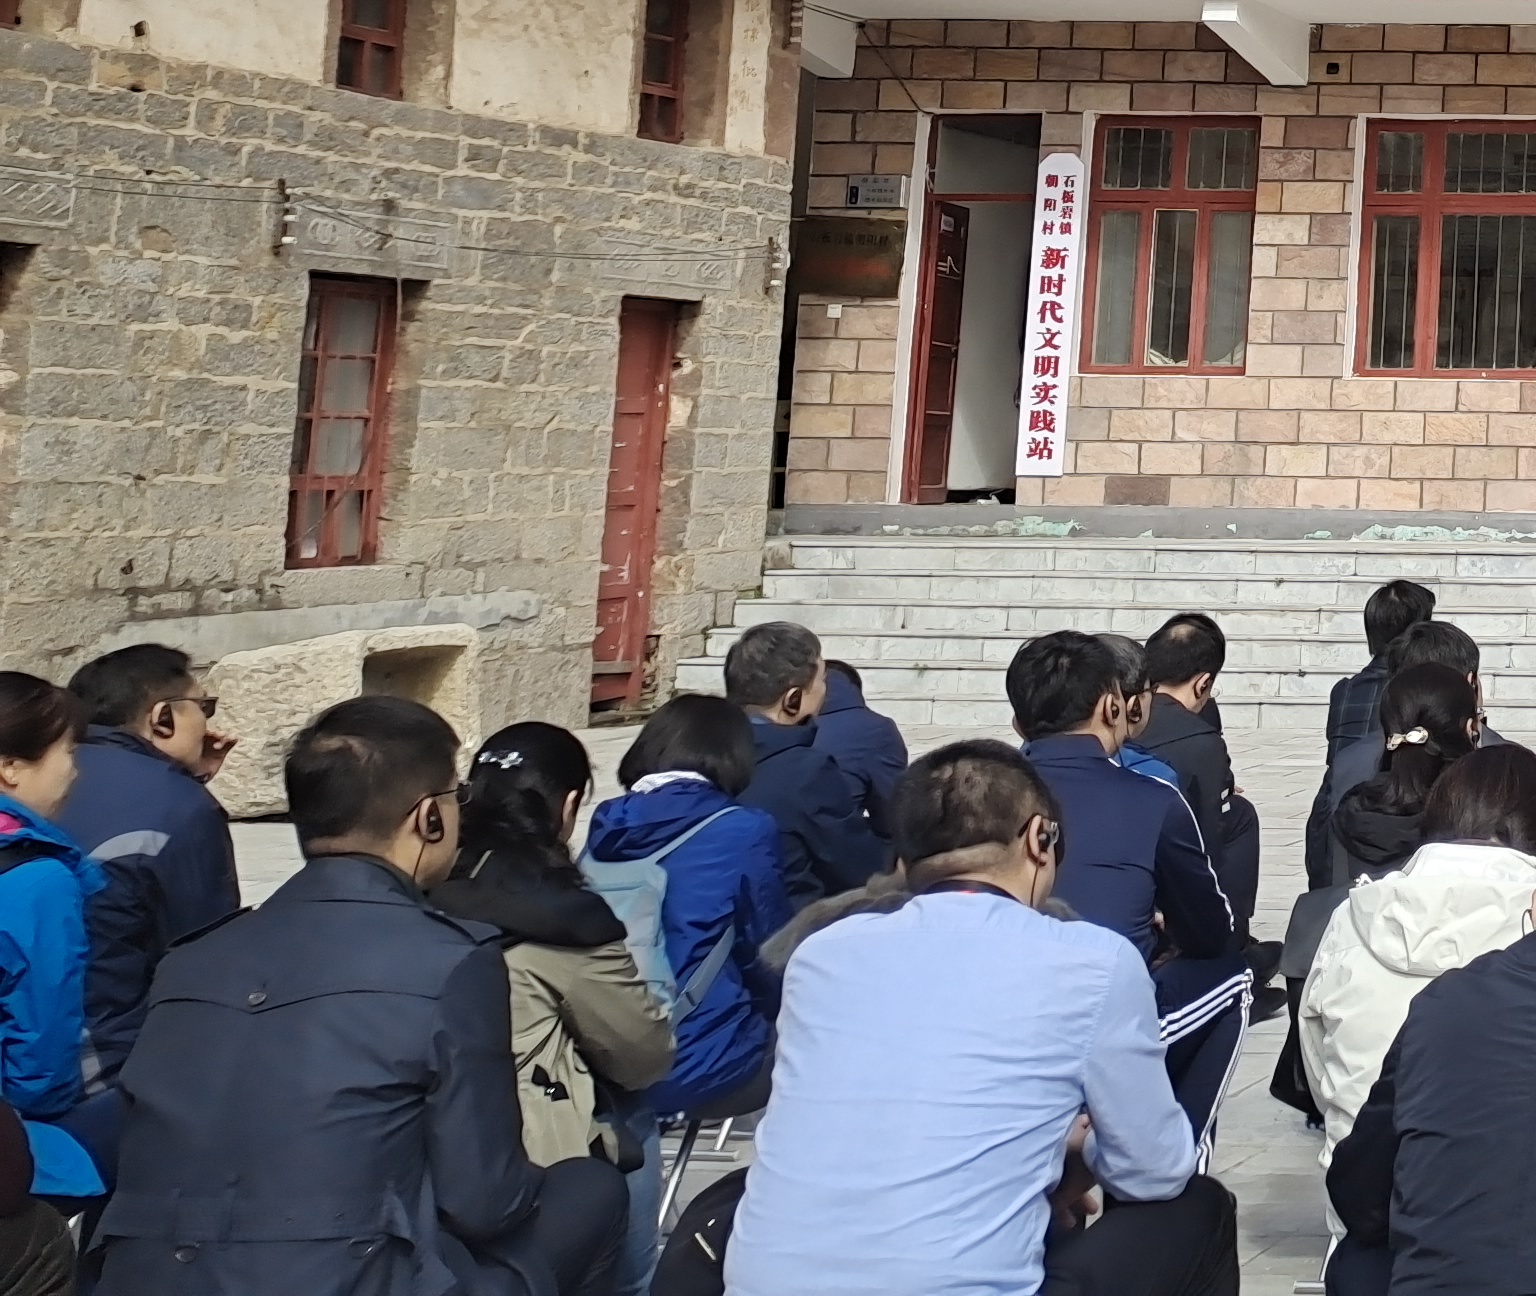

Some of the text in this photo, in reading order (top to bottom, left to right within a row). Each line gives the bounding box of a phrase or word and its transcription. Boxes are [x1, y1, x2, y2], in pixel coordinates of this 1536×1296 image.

[1026, 246, 1069, 461] 新时代文明实践站
